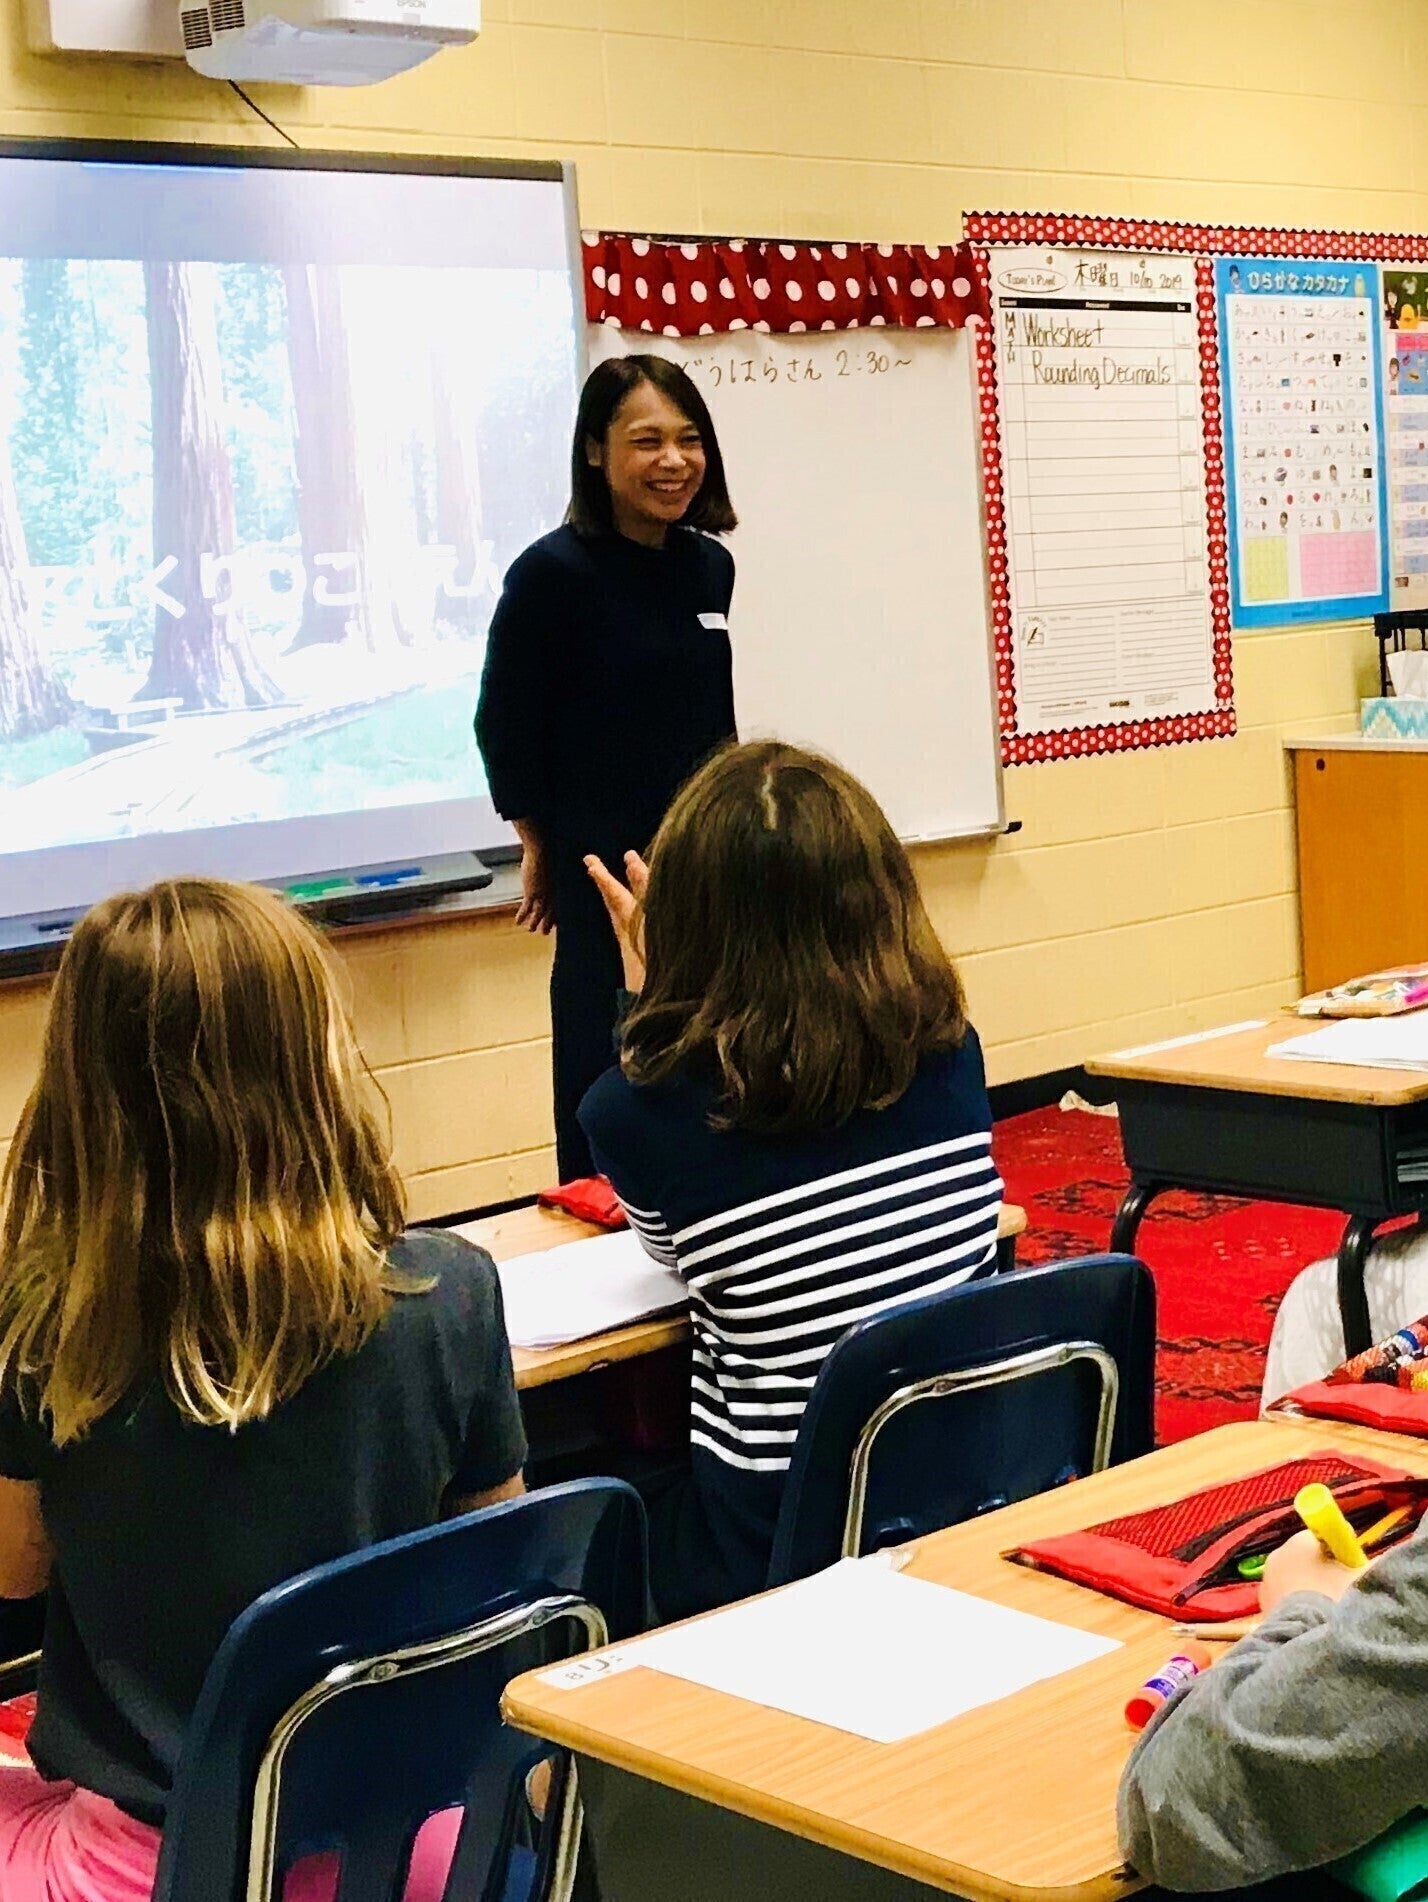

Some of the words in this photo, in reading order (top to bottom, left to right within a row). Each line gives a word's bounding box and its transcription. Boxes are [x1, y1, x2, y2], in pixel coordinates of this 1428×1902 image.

[1022, 310, 1105, 347] Worksheet
[1032, 350, 1101, 390] Rounding
[1102, 356, 1171, 385] Decimals
